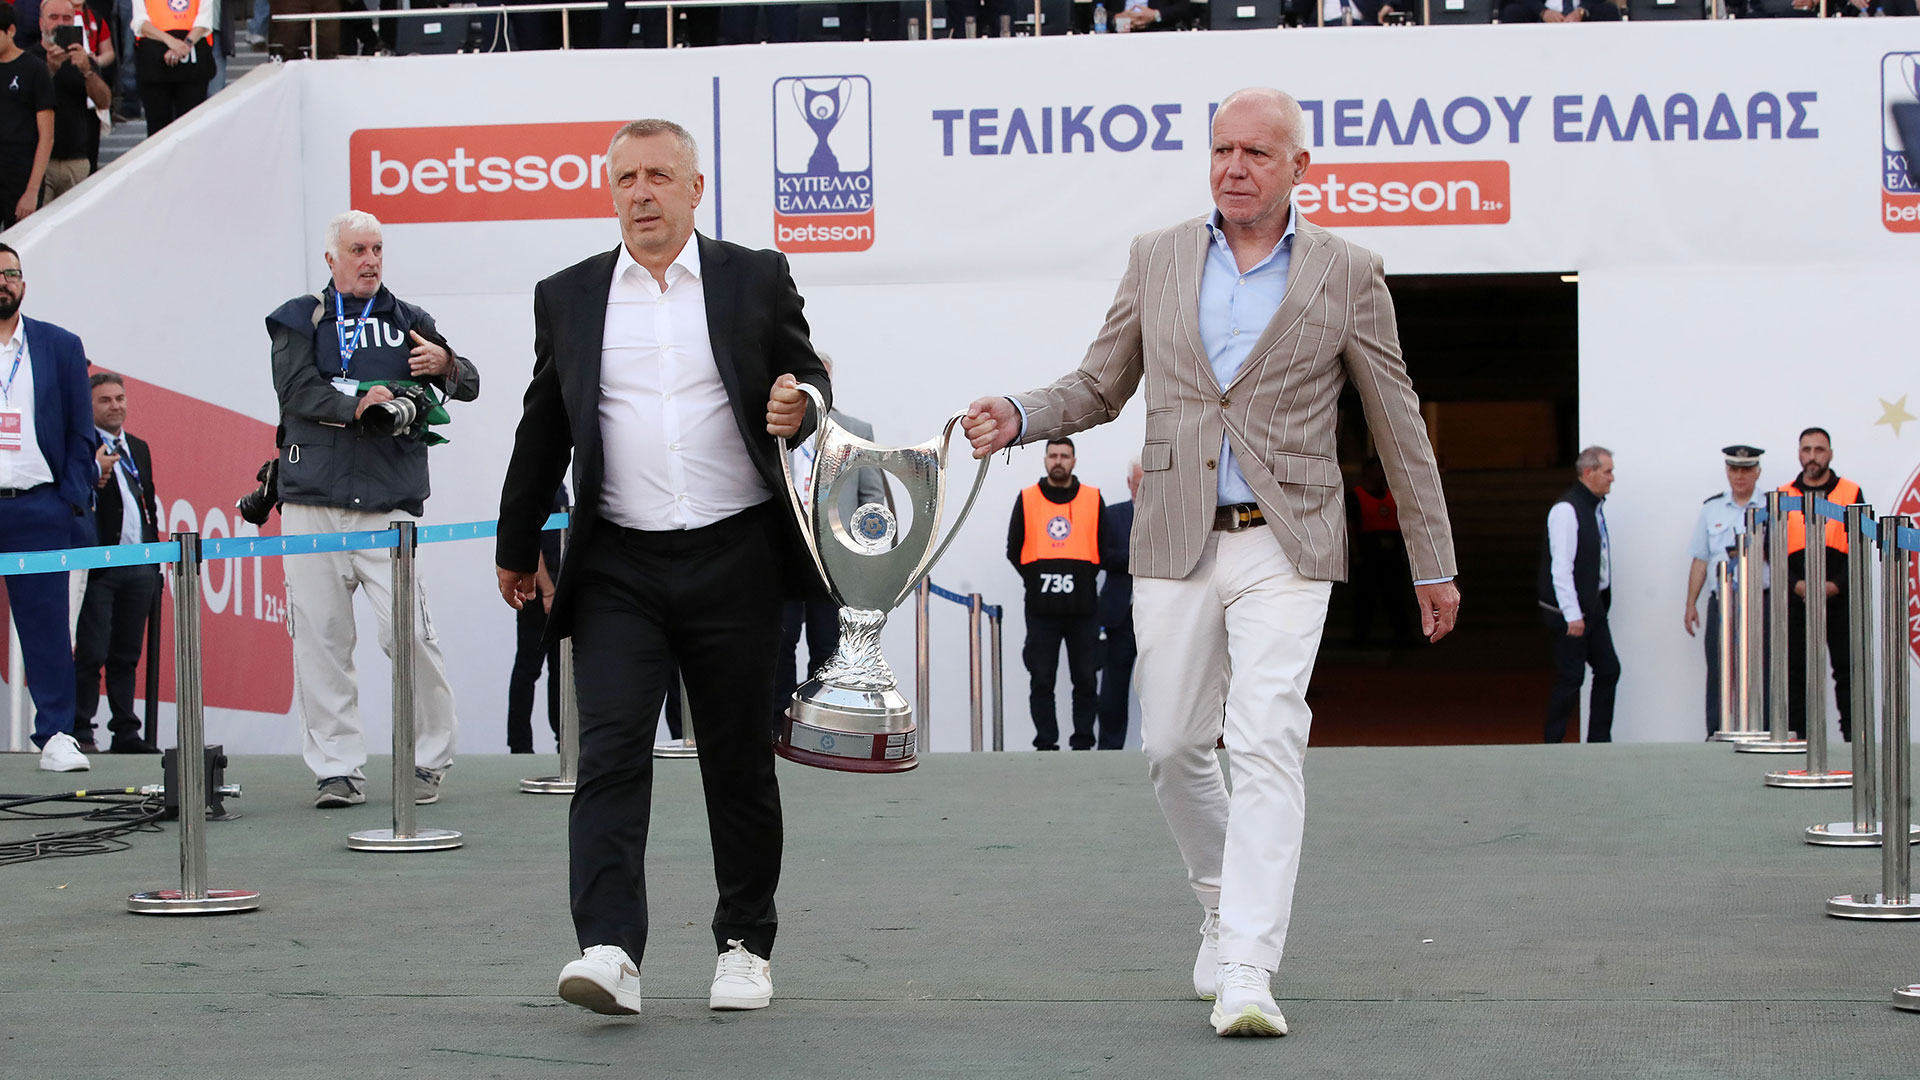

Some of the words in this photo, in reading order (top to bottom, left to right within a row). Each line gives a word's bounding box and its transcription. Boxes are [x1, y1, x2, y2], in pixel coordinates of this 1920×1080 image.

[931, 104, 1184, 157] ΤΕΛΙΚΟΣ
[1209, 95, 1532, 149] ΠΕΛΛΟΥ
[1552, 91, 1820, 143] ΕΛΛΑΔΑΣ
[778, 175, 871, 193] ΚΥΠΕΛΛΟ
[1290, 173, 1480, 215] etsson
[1481, 200, 1504, 211] 21+
[778, 193, 871, 211] ΕΛΛΑΔΑΣ
[777, 223, 871, 242] betsson
[1040, 573, 1075, 594] 736
